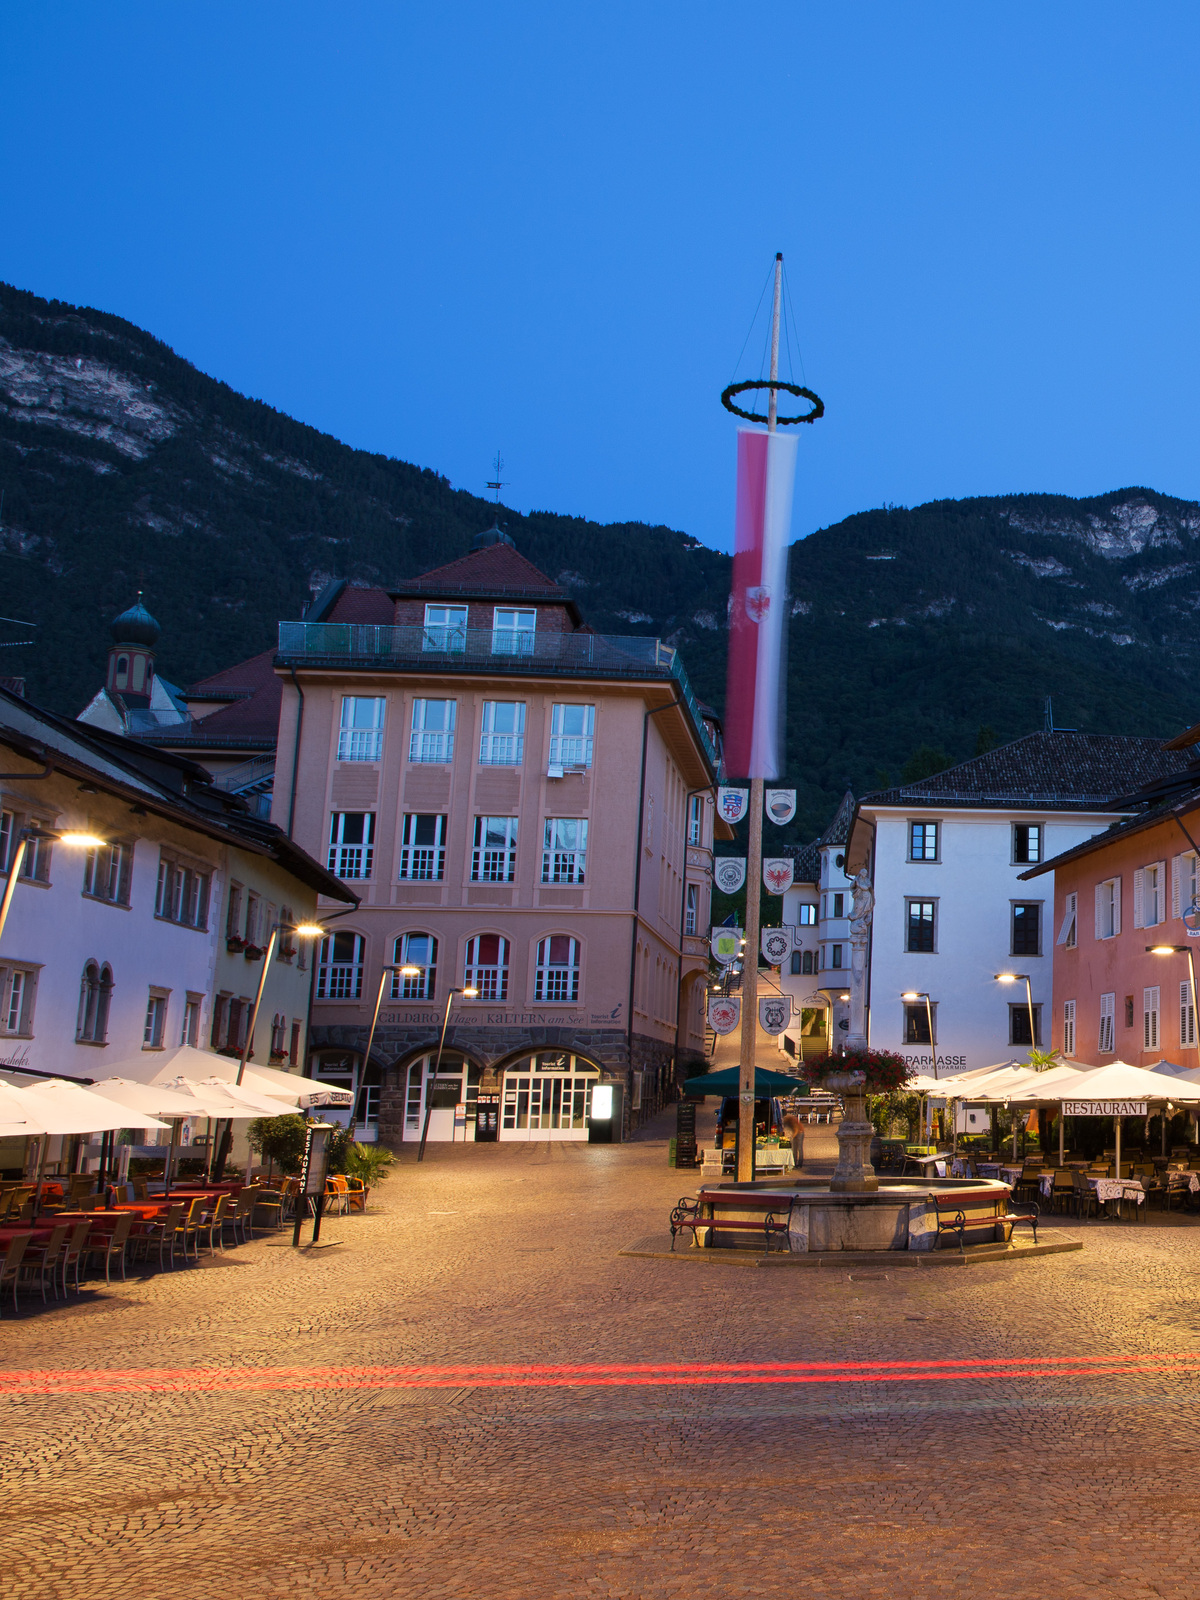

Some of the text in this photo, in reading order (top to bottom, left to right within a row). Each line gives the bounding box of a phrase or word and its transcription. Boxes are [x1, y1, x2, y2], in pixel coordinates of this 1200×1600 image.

[454, 1014, 478, 1026] lago
[548, 1016, 565, 1024] am
[567, 1014, 584, 1024] See
[1064, 1102, 1145, 1115] RESTAURANT
[299, 1128, 312, 1194] RESTAURANT
